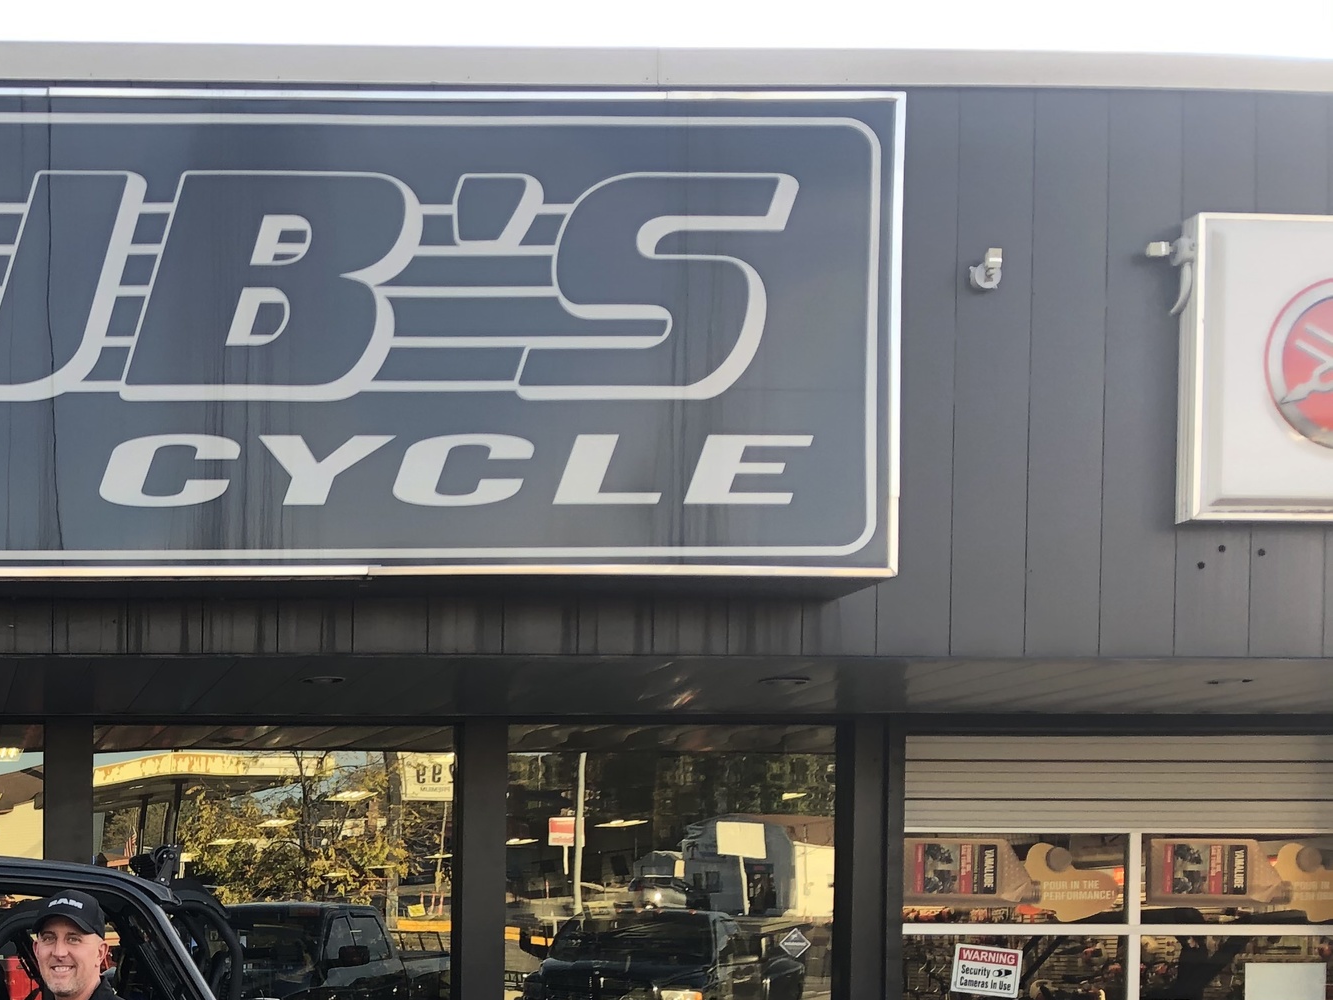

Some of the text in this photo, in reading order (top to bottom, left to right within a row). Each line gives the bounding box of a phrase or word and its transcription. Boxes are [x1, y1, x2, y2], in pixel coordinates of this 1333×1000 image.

[99, 432, 814, 508] CYCLE
[983, 848, 995, 889] YAMALUBE
[1233, 849, 1245, 889] YAMALUBE
[1043, 879, 1100, 891] POUR IN THE
[1043, 890, 1115, 901] PERFORMANCE!
[962, 948, 1016, 965] WARNING
[961, 964, 991, 979] Security
[959, 976, 1012, 991] Cameras In Use
